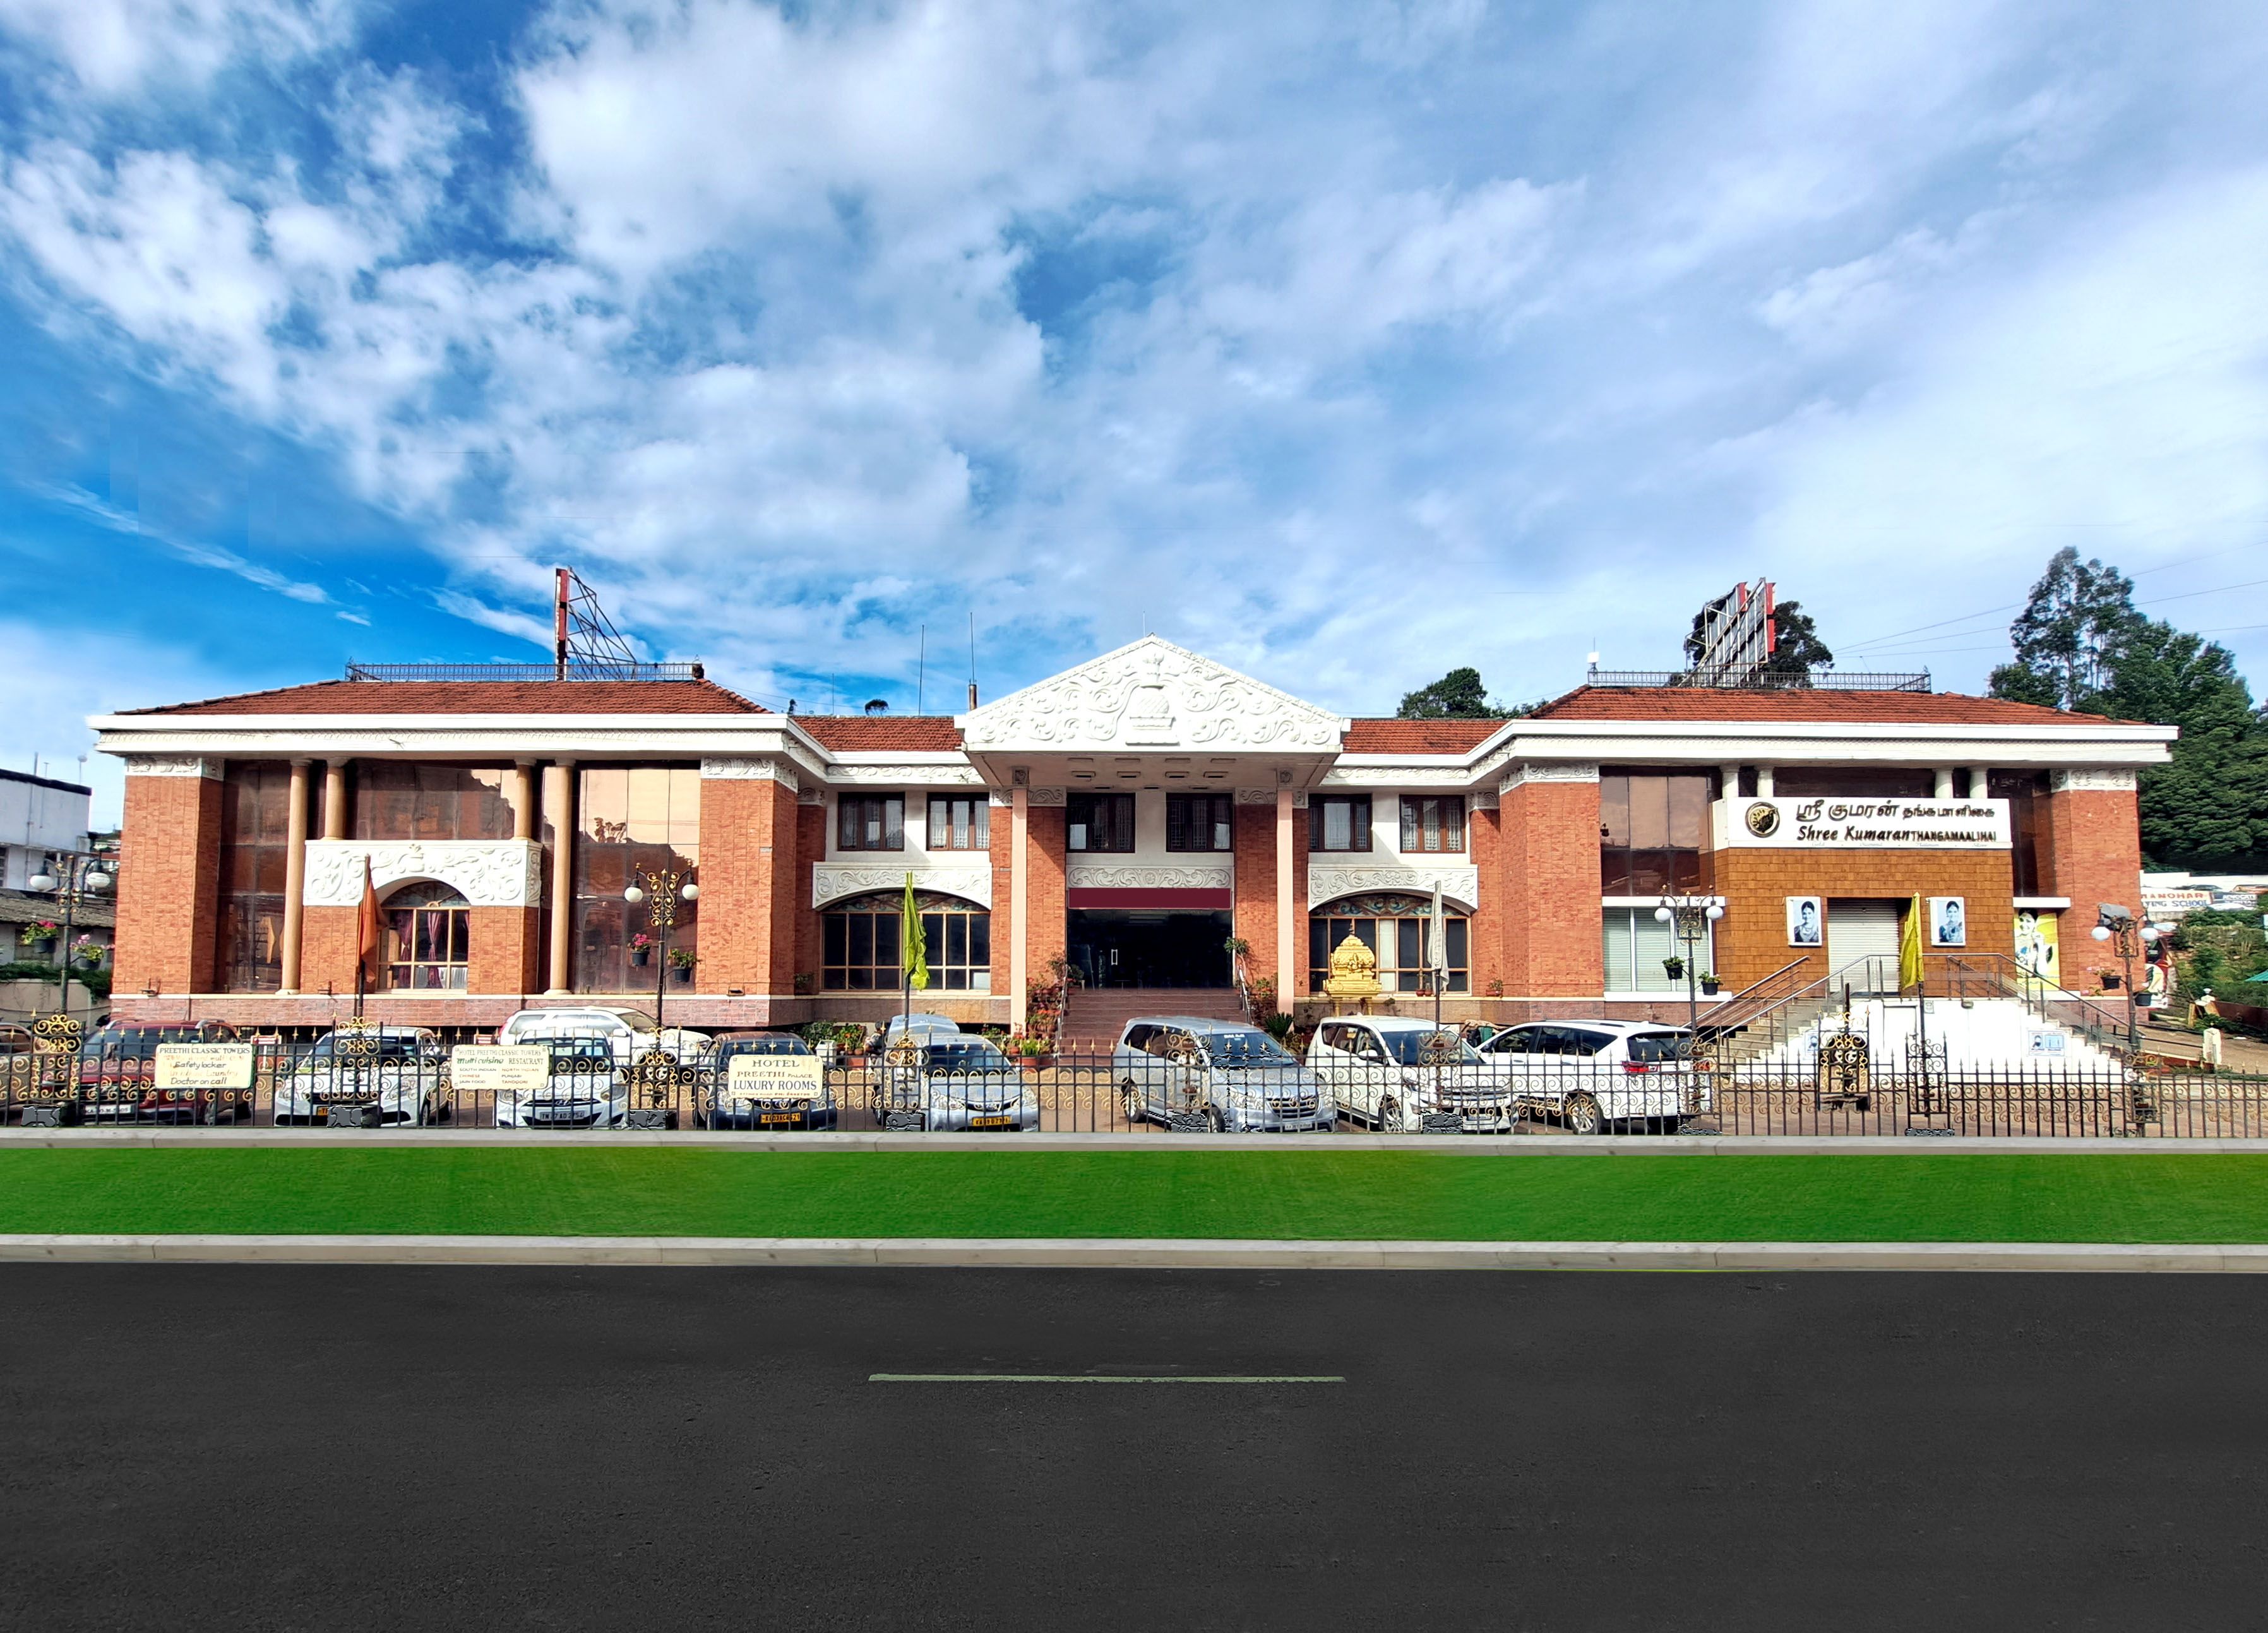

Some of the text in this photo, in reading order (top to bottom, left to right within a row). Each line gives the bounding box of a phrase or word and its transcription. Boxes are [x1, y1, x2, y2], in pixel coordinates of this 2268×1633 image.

[1829, 799, 1900, 821] குமரன்
[1797, 825, 1838, 841] Shree
[1844, 825, 1910, 841] Kumaran
[174, 1061, 200, 1070] Safety
[170, 1077, 198, 1085] Doctor
[210, 1077, 227, 1085] call
[734, 1080, 817, 1090] LUXURY ROOMS
